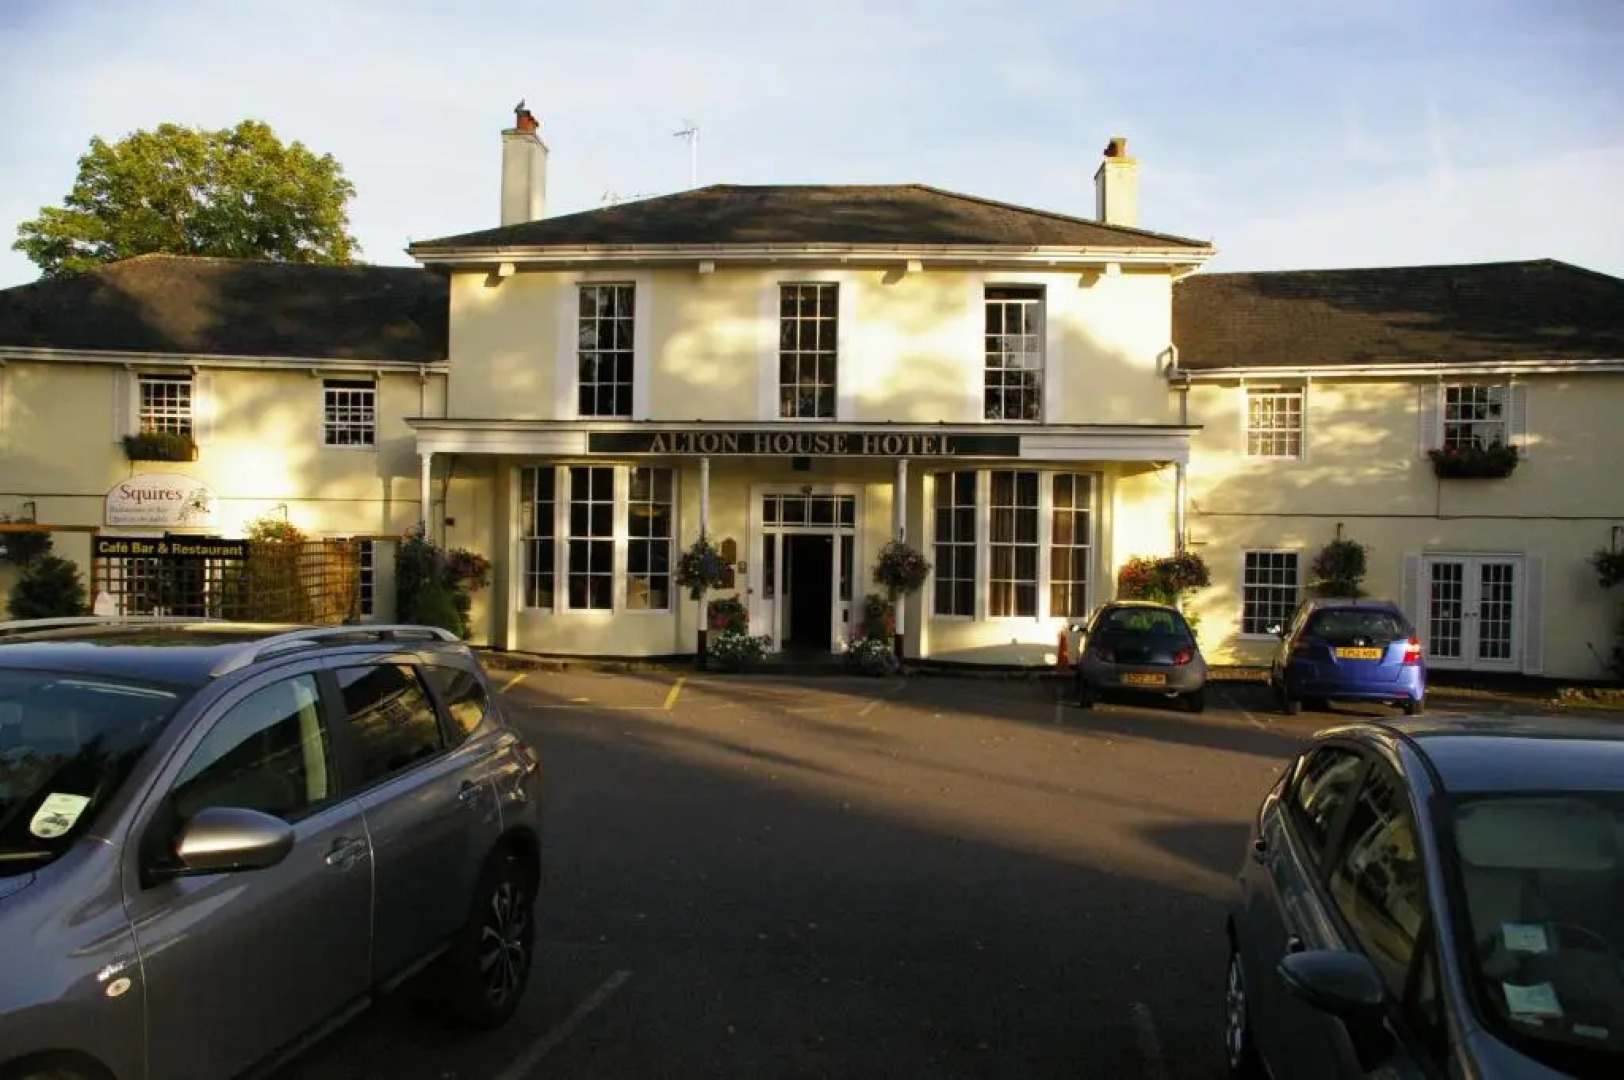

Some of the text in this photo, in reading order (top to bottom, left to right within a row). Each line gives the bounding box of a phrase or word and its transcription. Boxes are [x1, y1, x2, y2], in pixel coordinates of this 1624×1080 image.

[649, 431, 956, 455] ALTON HOUSE HOTEL
[119, 484, 183, 505] Squires
[132, 541, 155, 554] Bar
[172, 543, 243, 557] Restaurant
